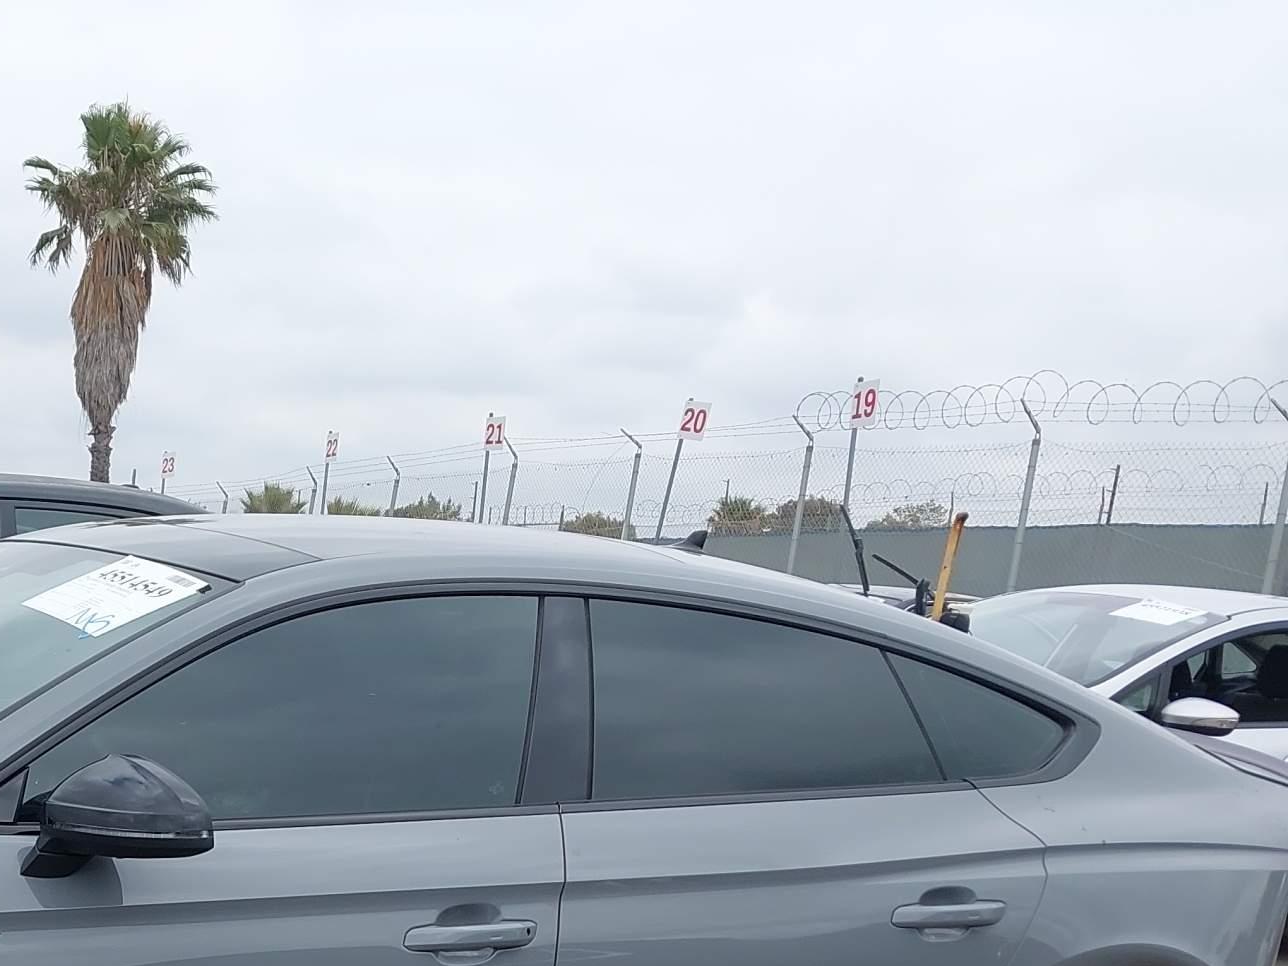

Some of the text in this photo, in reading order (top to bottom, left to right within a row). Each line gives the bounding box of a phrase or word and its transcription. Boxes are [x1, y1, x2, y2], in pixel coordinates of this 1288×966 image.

[852, 388, 876, 419] 19
[681, 408, 707, 433] 20
[486, 423, 503, 444] 21
[326, 438, 338, 457] 22
[162, 457, 175, 473] 23
[98, 569, 173, 598] 45514549
